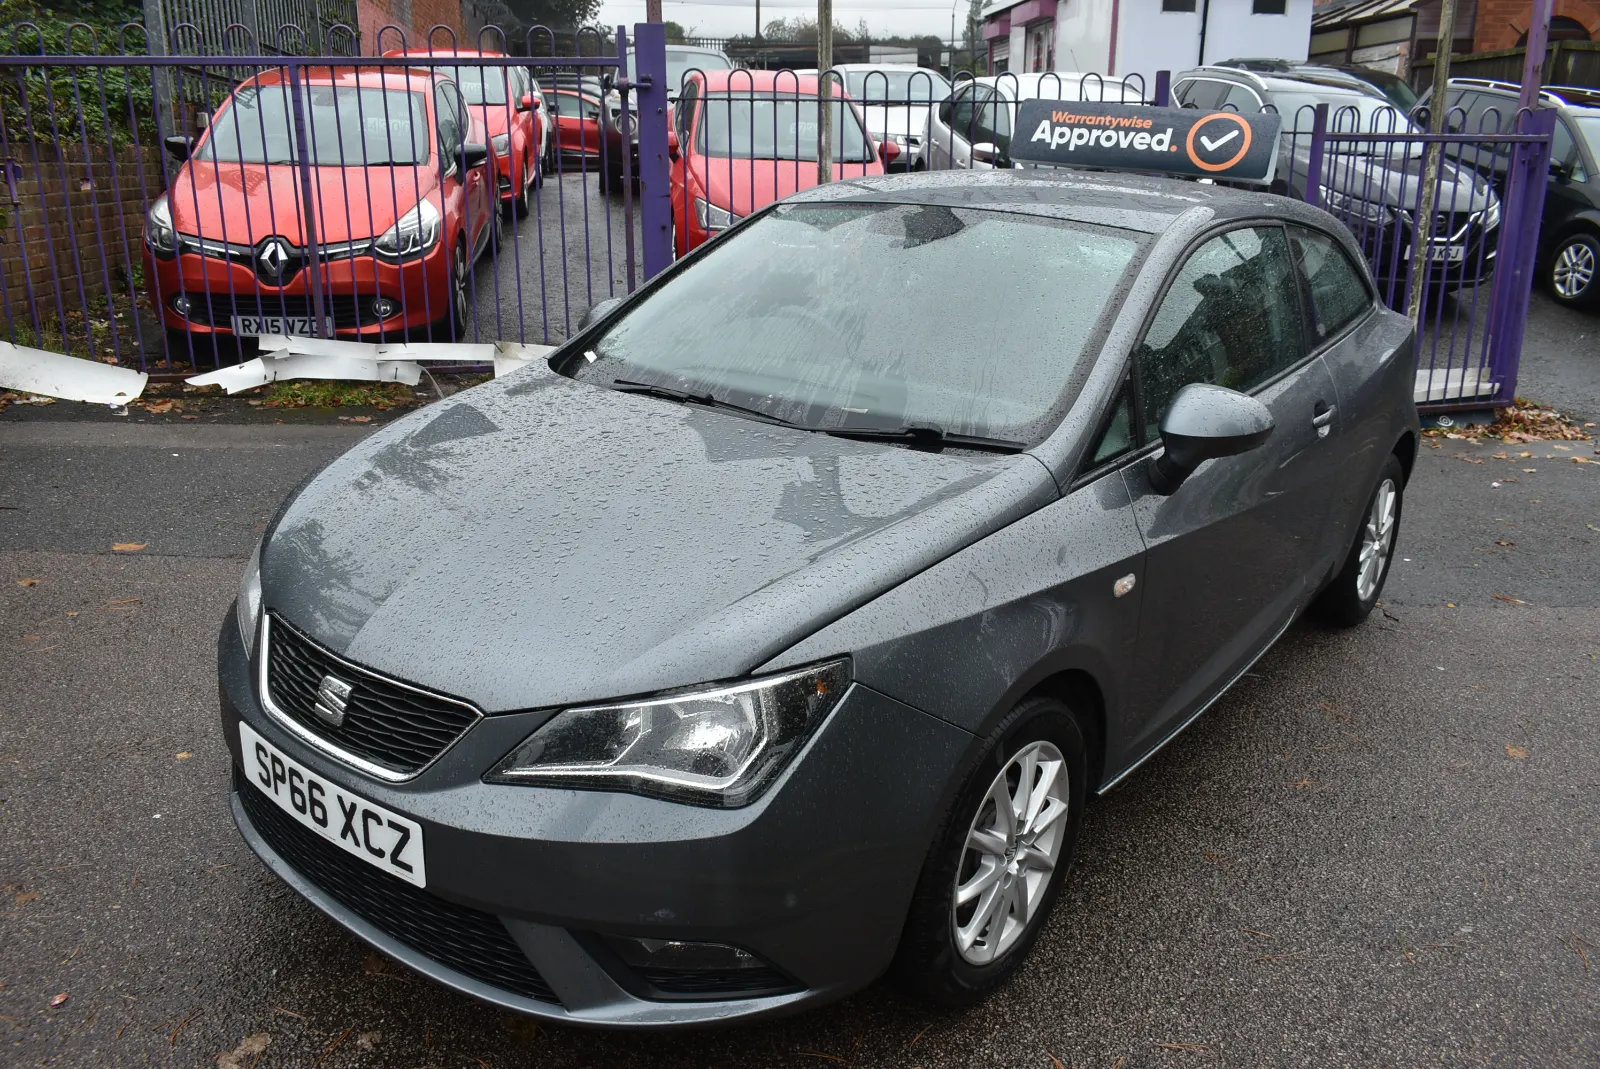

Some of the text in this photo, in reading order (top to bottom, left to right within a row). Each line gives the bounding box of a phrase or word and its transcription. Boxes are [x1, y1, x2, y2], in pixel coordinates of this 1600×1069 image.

[1052, 110, 1153, 129] Warrantywise
[1031, 119, 1178, 152] Approved.
[242, 318, 281, 334] RX15
[255, 741, 414, 874] SP66 XCZ
